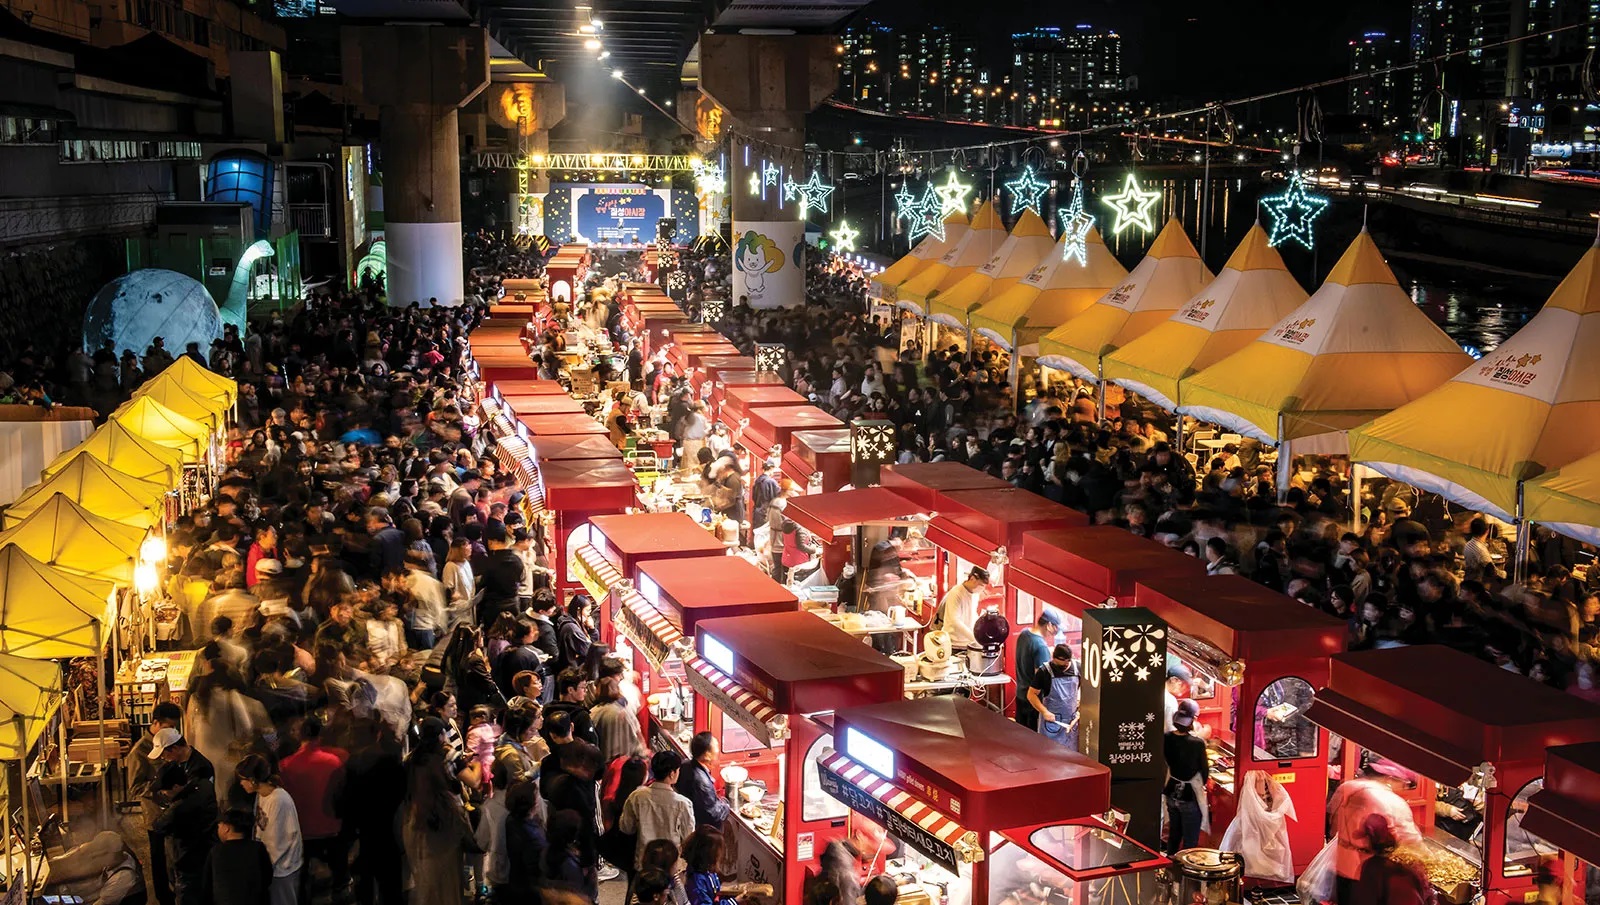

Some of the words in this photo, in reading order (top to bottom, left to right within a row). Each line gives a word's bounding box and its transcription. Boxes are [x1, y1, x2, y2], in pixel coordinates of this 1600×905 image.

[1492, 366, 1537, 385] 칠성야시장
[1082, 636, 1101, 689] 10
[1108, 752, 1152, 765] 칠성야시장
